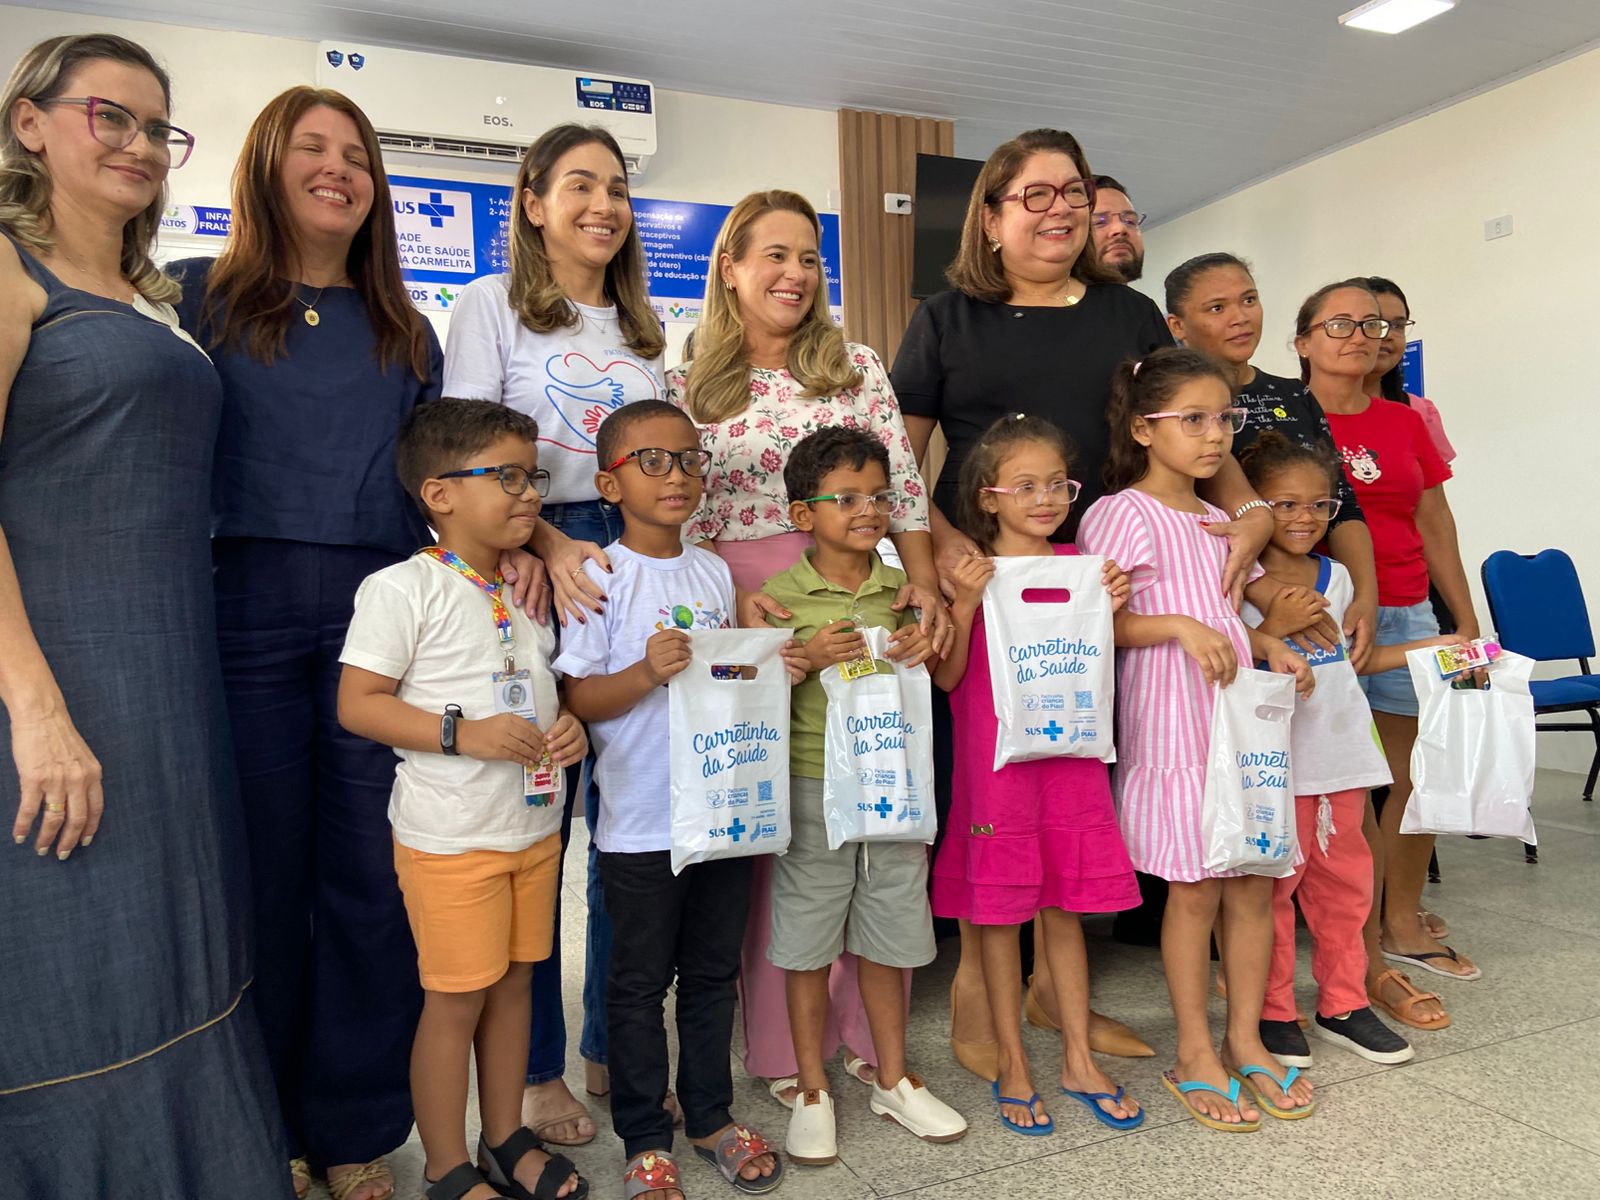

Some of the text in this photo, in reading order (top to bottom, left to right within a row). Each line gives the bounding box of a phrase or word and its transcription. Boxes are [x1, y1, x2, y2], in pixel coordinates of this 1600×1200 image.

[483, 115, 513, 127] EOS.
[394, 200, 416, 214] US
[633, 211, 674, 221] spensação
[399, 244, 471, 258] CA DE SAÚDE
[654, 252, 694, 260] preventivo
[694, 253, 711, 262] (cân
[411, 256, 473, 269] CARMELITA
[658, 260, 681, 271] útero)
[653, 270, 663, 278] de
[664, 271, 700, 281] educação
[1008, 637, 1102, 664] Carretinha
[1017, 656, 1088, 684] da Saúde
[693, 720, 781, 754] Carretinha
[1025, 727, 1042, 736] SUS
[853, 731, 907, 757] da Saú
[702, 743, 769, 778] da Saúde
[1256, 770, 1288, 789] Saú
[857, 802, 873, 812] SUS
[709, 827, 726, 839] SUS
